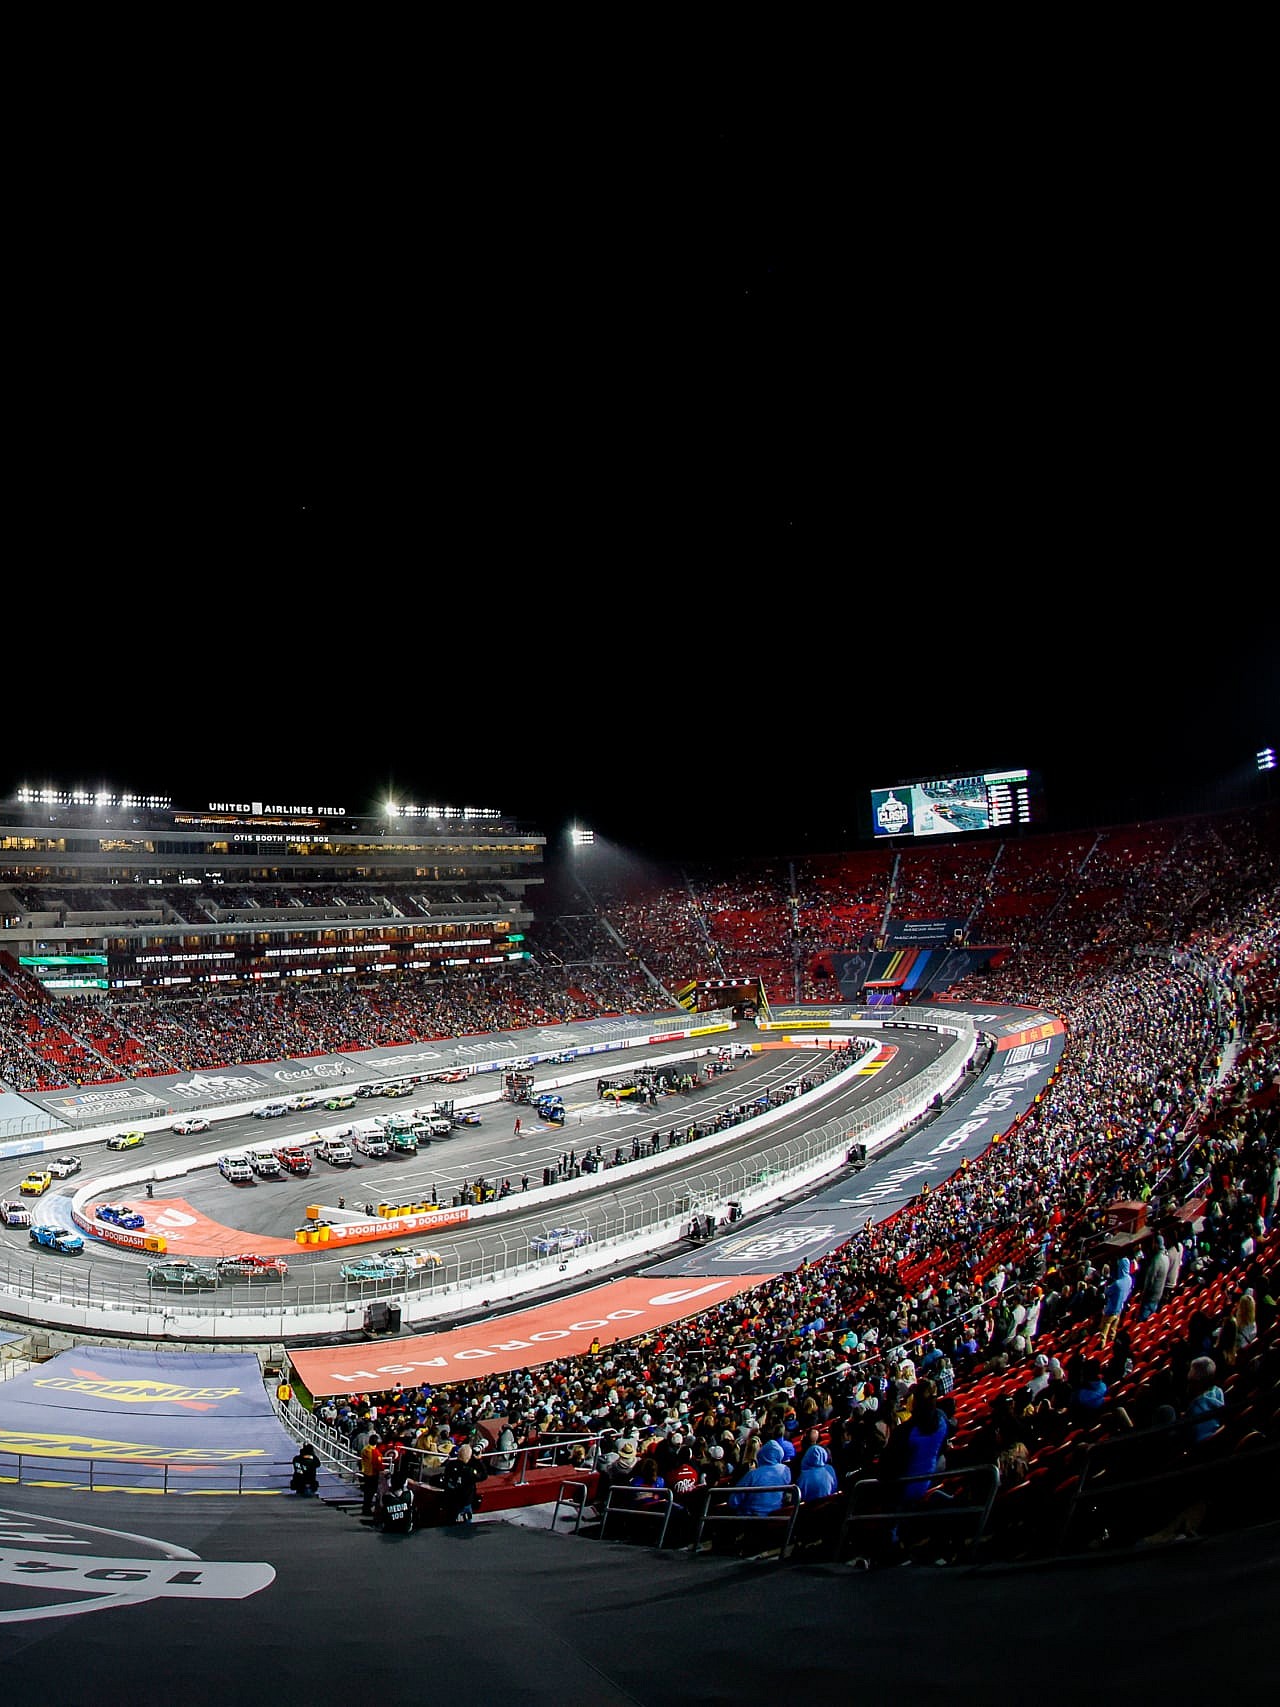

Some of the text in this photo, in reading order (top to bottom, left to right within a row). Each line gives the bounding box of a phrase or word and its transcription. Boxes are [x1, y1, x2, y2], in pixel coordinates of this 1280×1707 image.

[209, 802, 346, 815] UNITED AIRLINES FIELD
[233, 834, 329, 843] OTIS BOOTH PRESS BOX
[172, 1075, 268, 1099] BUSCH
[79, 1090, 131, 1104] NASCAR
[419, 1209, 467, 1226] DOORDASH
[349, 1221, 400, 1236] DOORDASH
[104, 1231, 144, 1247] DOORDASH
[329, 1308, 646, 1386] DOORDASH
[42, 1377, 240, 1402] SUNOCO
[386, 1502, 409, 1514] MEDIA
